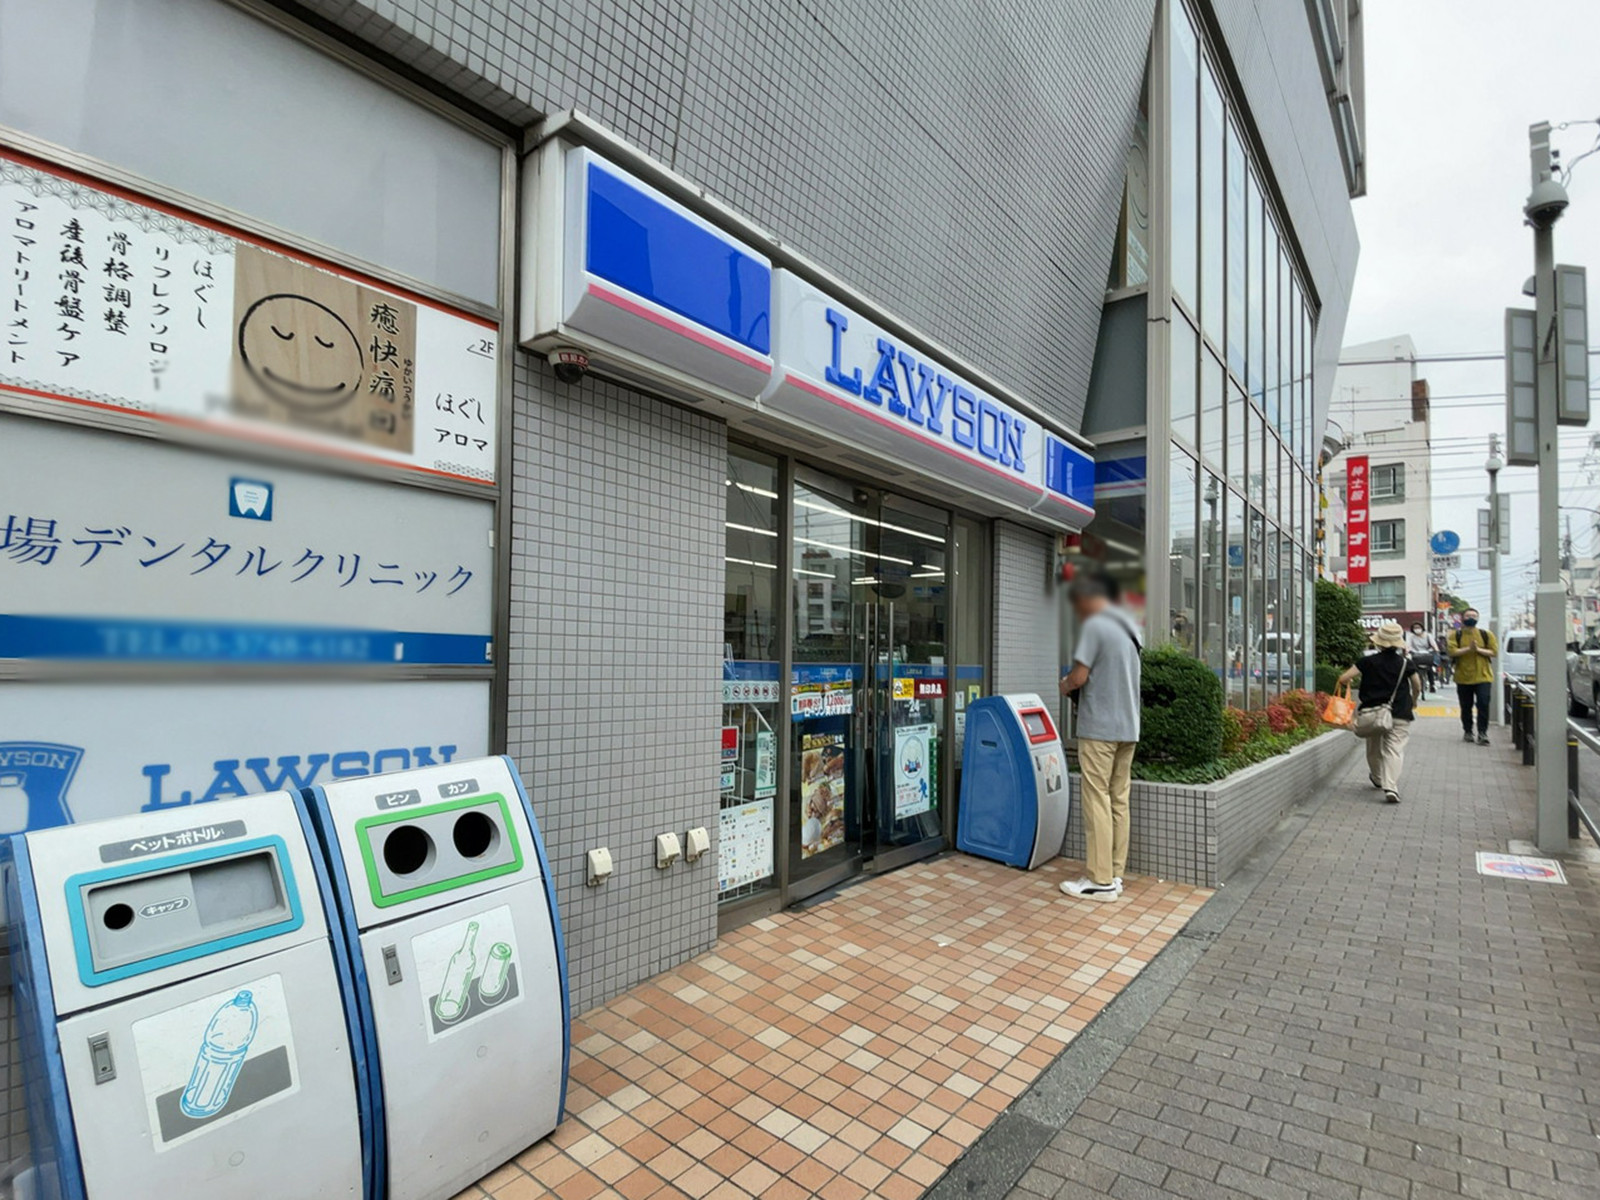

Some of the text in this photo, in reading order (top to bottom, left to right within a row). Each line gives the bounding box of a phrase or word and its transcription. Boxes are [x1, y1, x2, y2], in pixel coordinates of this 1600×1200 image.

[7, 200, 39, 364] アロマトリートメント
[53, 218, 89, 367] 産後骨盤ケア
[102, 231, 135, 336] 骨格調整
[192, 259, 215, 330] ほぐし
[479, 338, 494, 354] 2F
[825, 307, 1026, 473] LAWSON
[435, 392, 486, 426] ほぐし
[433, 427, 489, 452] アロマ
[0, 514, 475, 597] 場デンタルクリニック
[386, 795, 410, 806] ビン
[448, 783, 469, 795] カン
[129, 827, 225, 852] ペットボトル
[146, 900, 184, 915] キャップ
